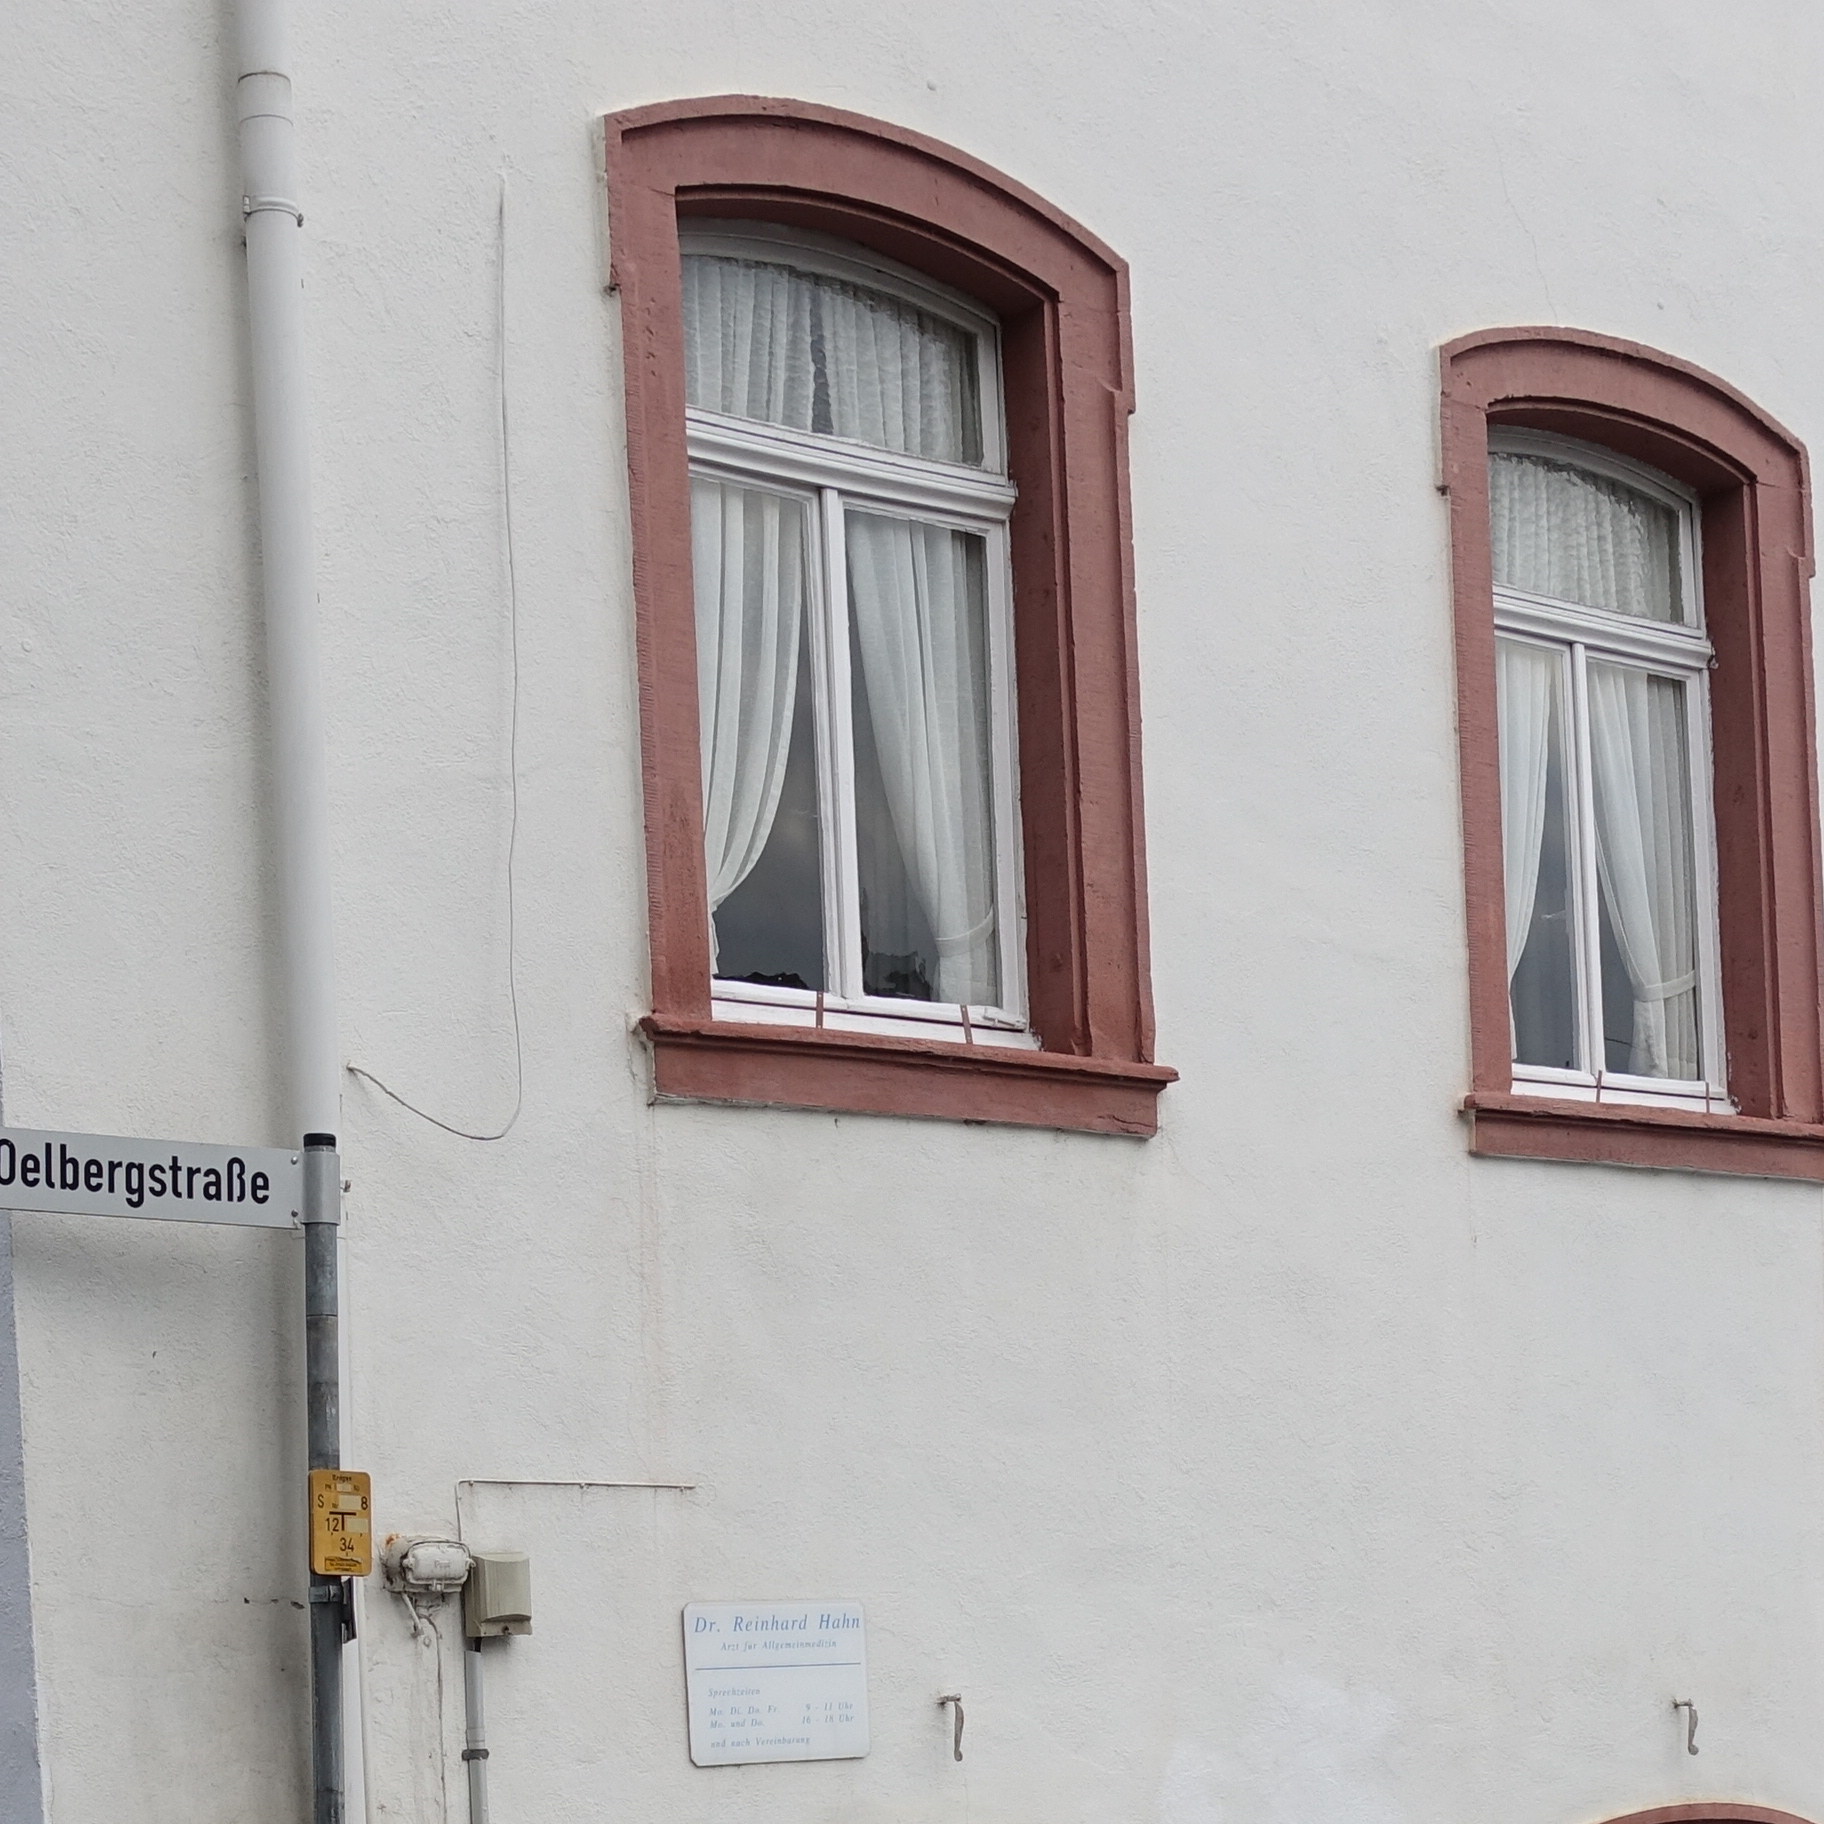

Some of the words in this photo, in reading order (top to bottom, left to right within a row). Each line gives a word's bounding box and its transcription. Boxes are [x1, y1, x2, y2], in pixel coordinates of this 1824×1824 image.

[317, 1494, 324, 1509] S
[361, 1496, 368, 1510] 8
[694, 1616, 721, 1633] Dr.
[733, 1614, 808, 1633] Reinhard
[818, 1613, 860, 1630] Hahn
